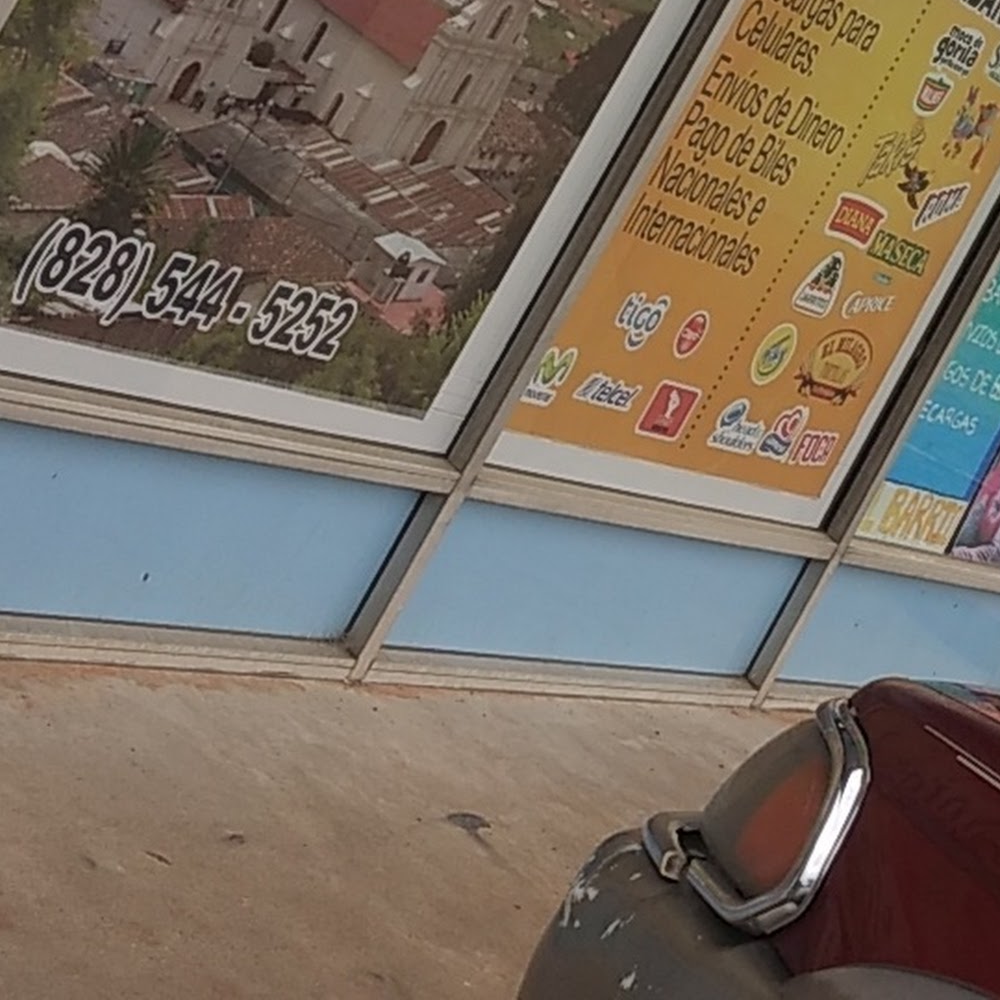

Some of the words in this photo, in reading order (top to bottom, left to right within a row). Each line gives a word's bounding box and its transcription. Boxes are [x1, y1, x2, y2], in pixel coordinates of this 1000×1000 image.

[831, 8, 881, 52] para
[700, 53, 769, 119] Envíos
[762, 87, 789, 128] de
[786, 96, 845, 154] Dinero
[673, 99, 723, 162] Pago
[723, 125, 754, 167] de
[749, 133, 797, 187] Biles
[648, 146, 755, 222] Nacionales
[749, 195, 767, 226] e
[622, 192, 761, 277] Internacionales
[834, 204, 876, 238] DIANA
[870, 232, 930, 274] MASECA
[13, 218, 155, 326] (828)
[145, 252, 243, 332] 544
[248, 281, 357, 361] 5252
[943, 360, 972, 388] GOS
[918, 400, 980, 436] ECARGAS
